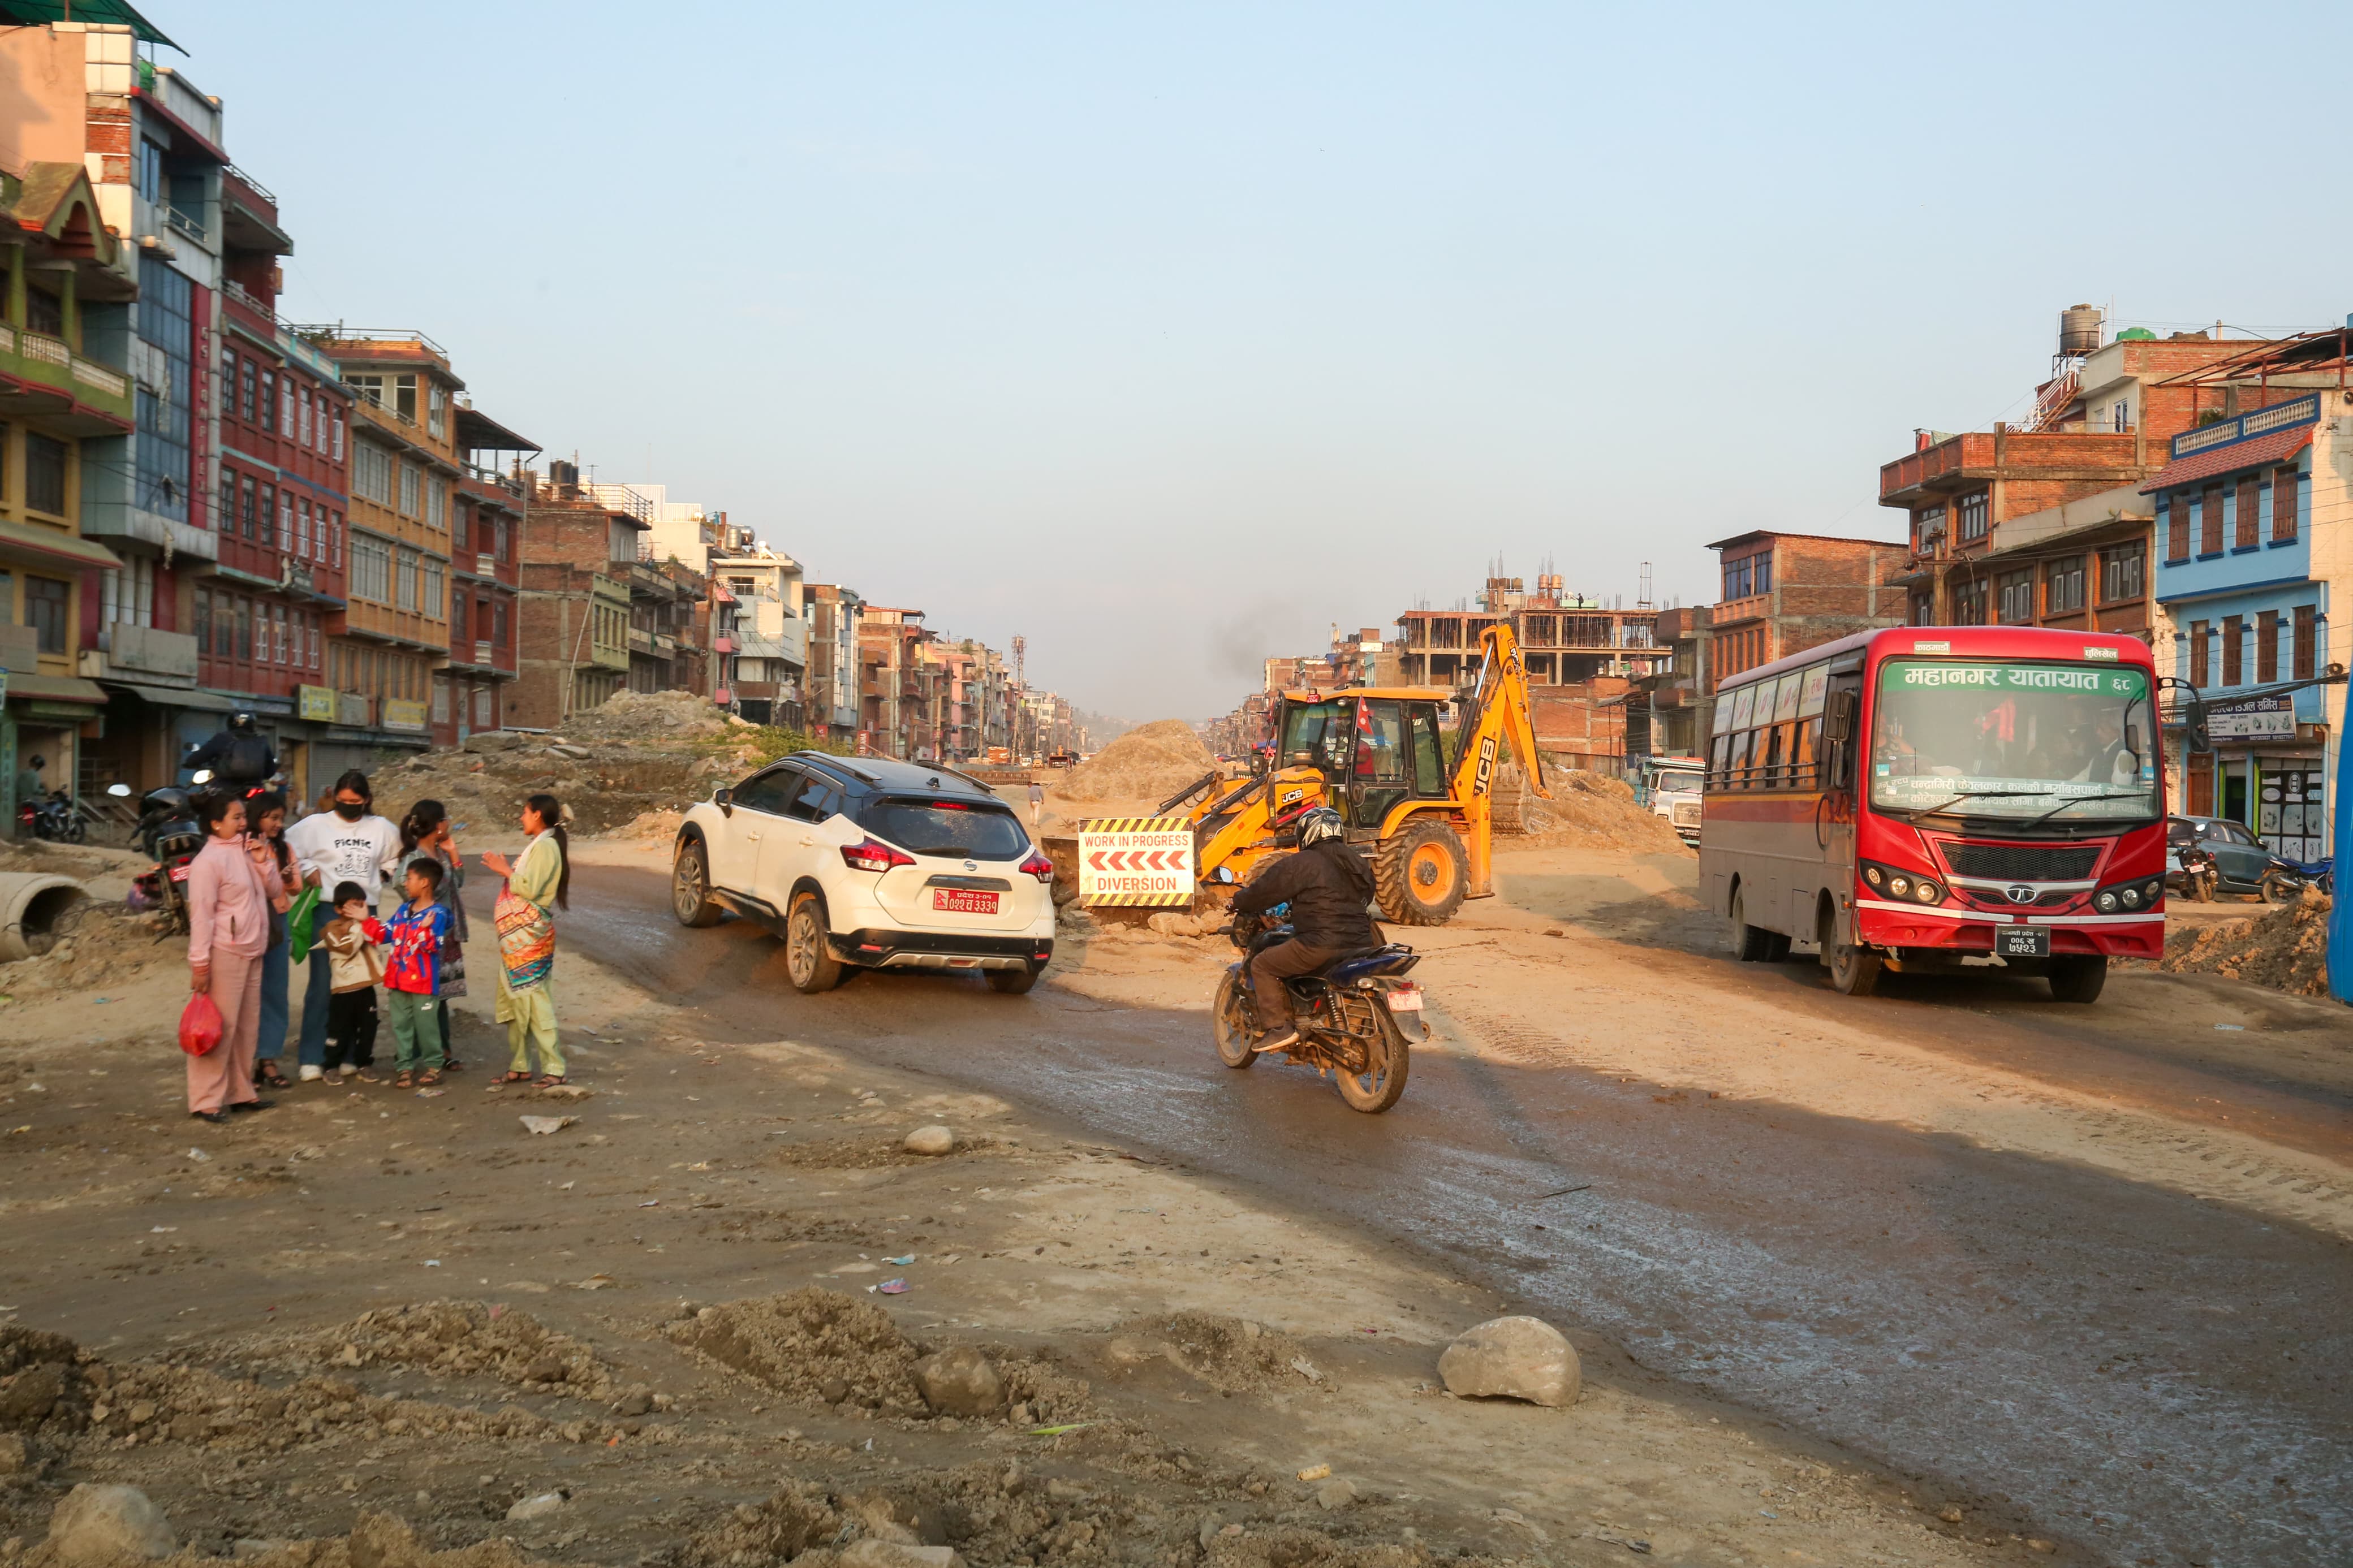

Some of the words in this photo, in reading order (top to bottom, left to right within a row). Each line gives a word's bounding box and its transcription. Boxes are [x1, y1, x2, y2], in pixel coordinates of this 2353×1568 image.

[1904, 668, 2002, 686] महानगर
[2008, 669, 2100, 690] यातायात
[2113, 678, 2131, 691] ६८
[1474, 738, 1494, 793] JCB
[1282, 789, 1303, 803] JCB
[1085, 835, 1115, 847] WORK
[1119, 836, 1129, 846] IN
[1132, 835, 1188, 846] PROGRESS
[1097, 877, 1176, 891] DIVERSION
[949, 899, 965, 910] ०२२
[966, 899, 973, 911] च
[974, 900, 997, 913] ३३३१
[2009, 943, 2036, 954] ७५२३
